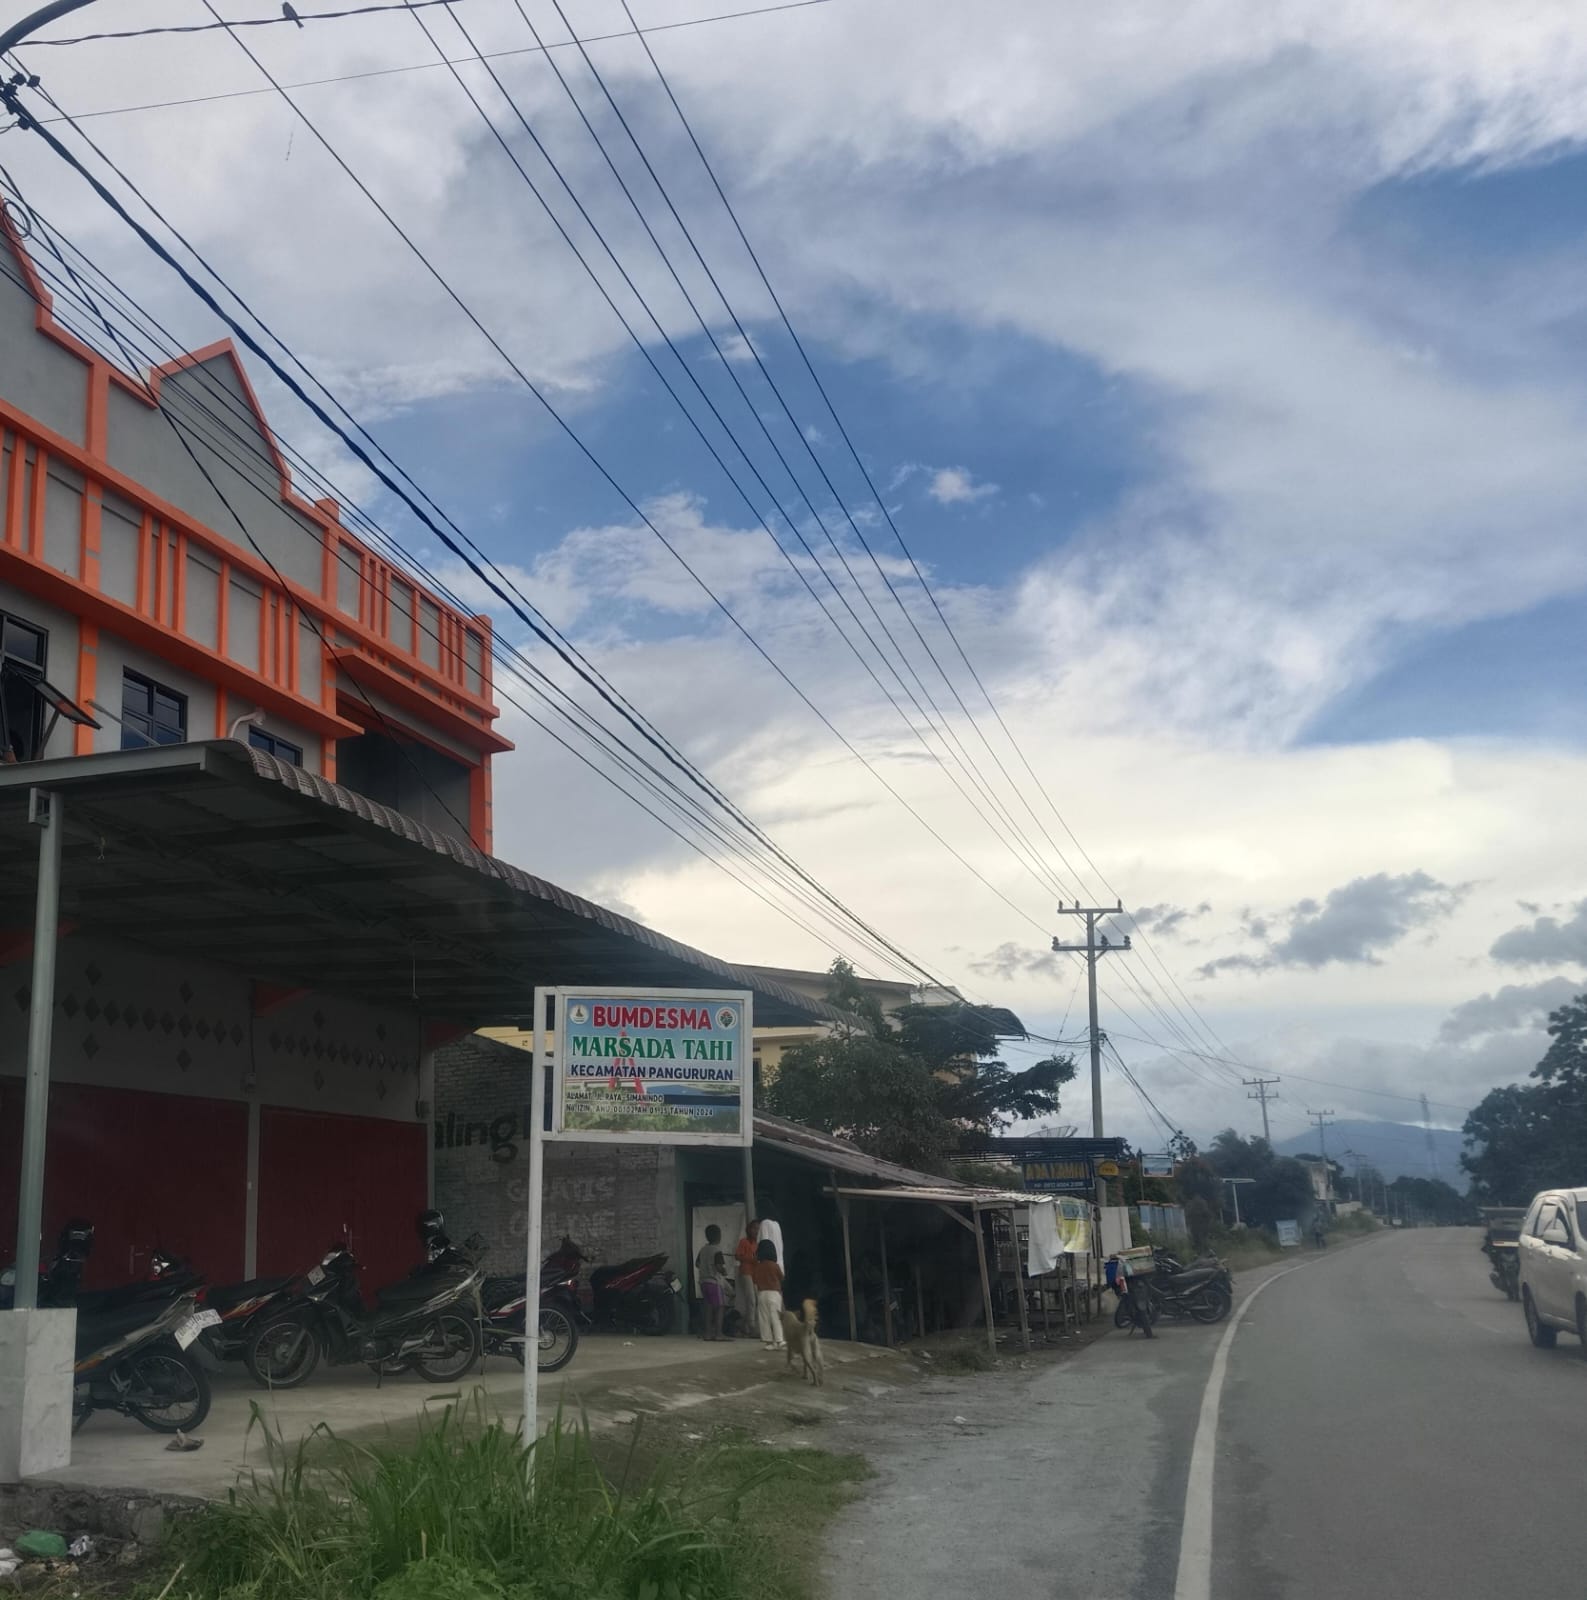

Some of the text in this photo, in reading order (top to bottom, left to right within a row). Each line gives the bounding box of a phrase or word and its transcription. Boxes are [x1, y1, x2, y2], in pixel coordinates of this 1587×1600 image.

[593, 1005, 712, 1029] BUMDESMA
[572, 1036, 733, 1061] MARSADA TAHI
[570, 1064, 733, 1080] KECAMATAN PANGURURAN
